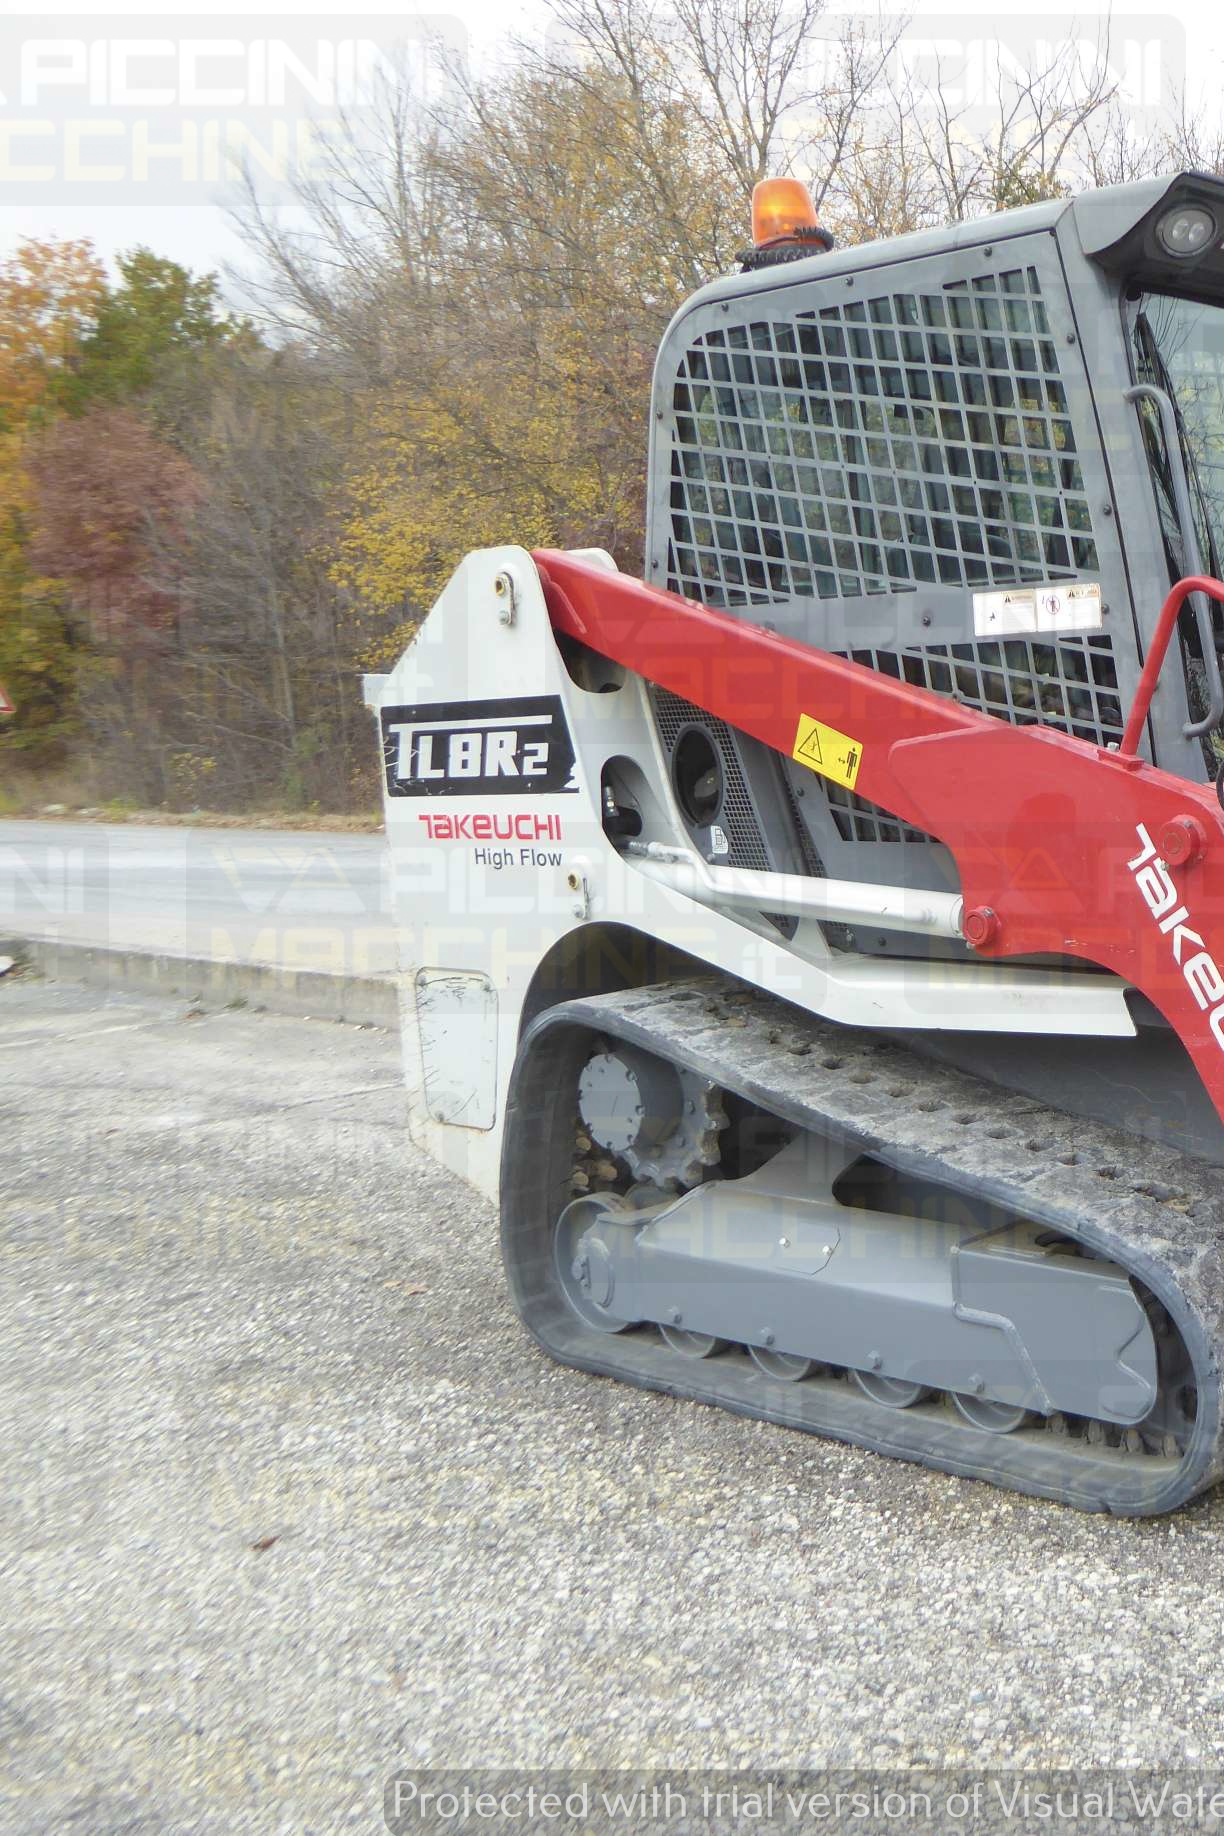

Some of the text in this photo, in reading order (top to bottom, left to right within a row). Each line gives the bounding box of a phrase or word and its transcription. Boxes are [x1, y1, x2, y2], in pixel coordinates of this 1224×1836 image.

[389, 715, 552, 779] TL8R2
[475, 848, 562, 870] High Flow
